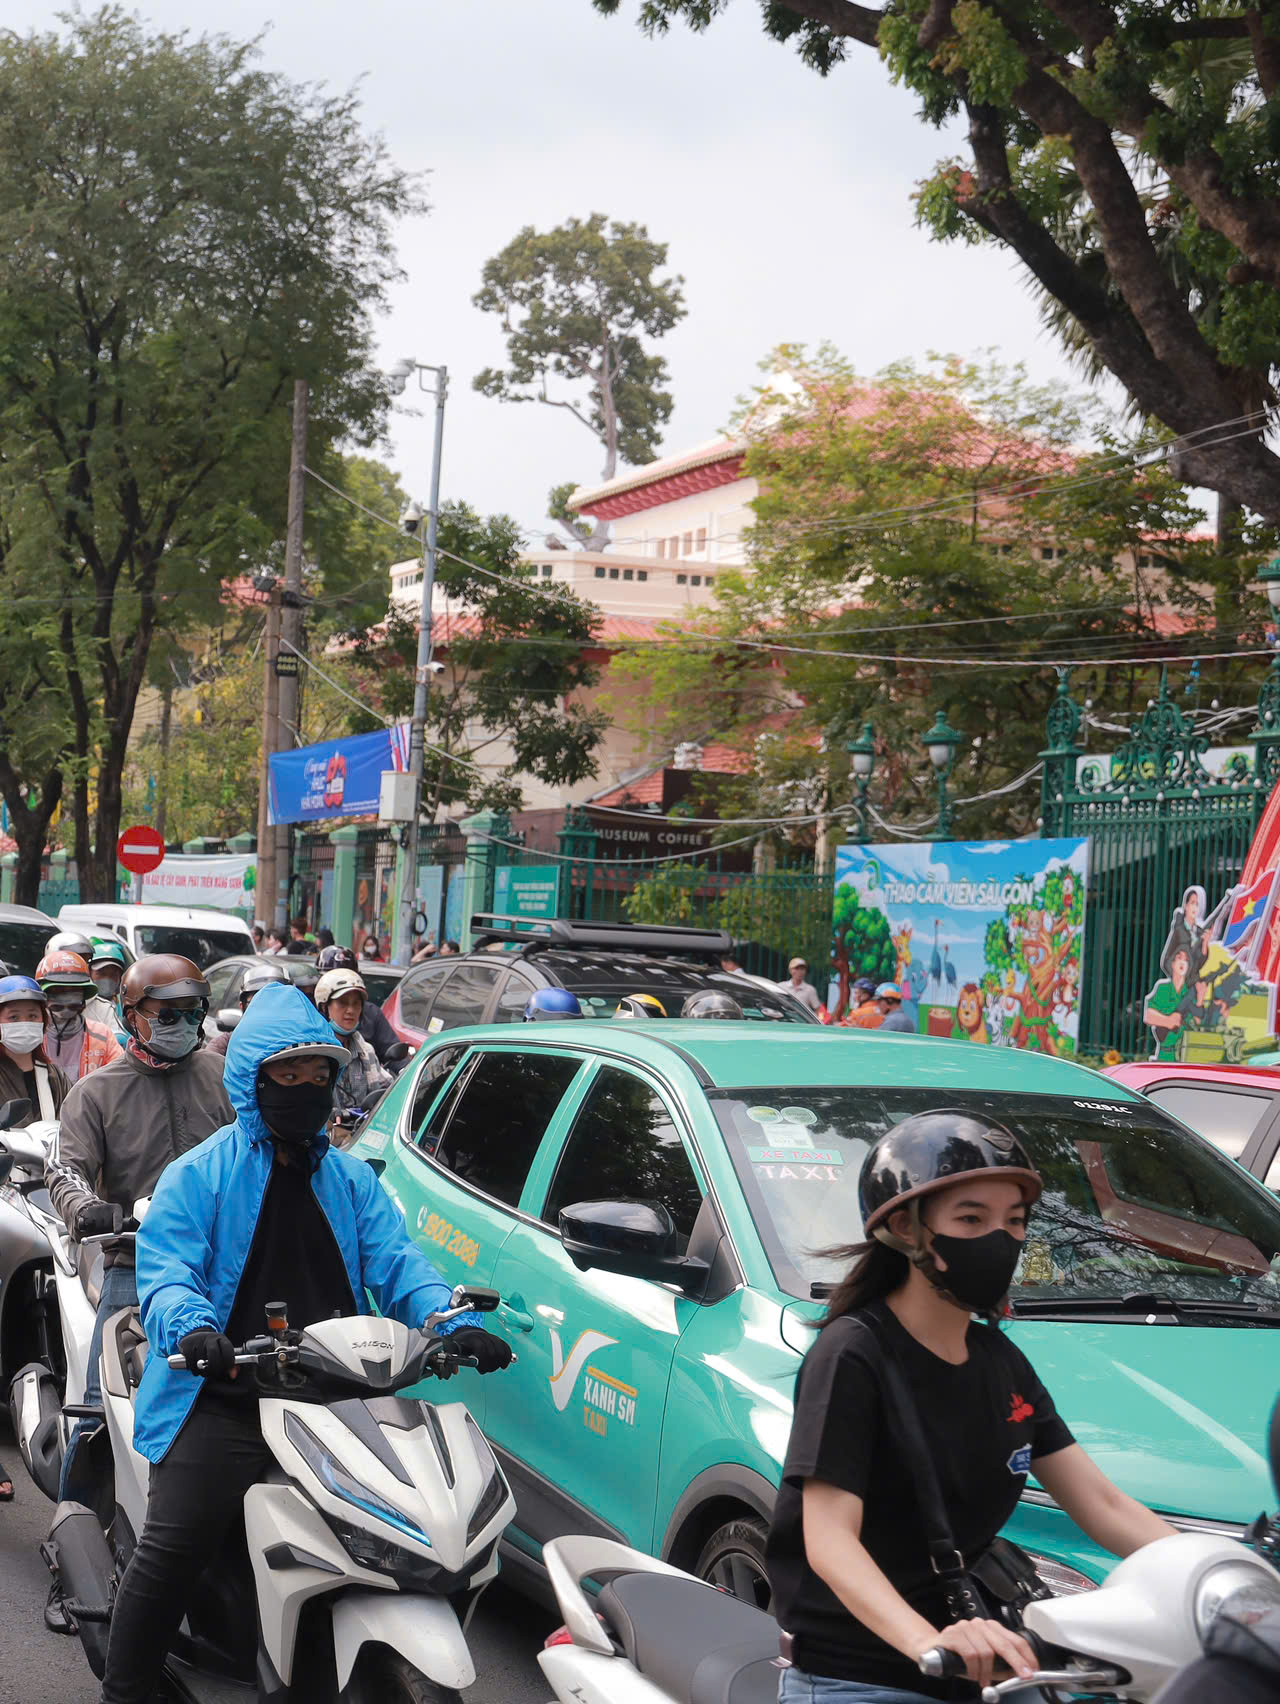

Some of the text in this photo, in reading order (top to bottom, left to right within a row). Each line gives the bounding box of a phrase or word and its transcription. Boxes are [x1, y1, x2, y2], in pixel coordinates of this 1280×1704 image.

[594, 829, 703, 845] MUSEUM COFFEE
[761, 1150, 832, 1160] XE TAXI
[760, 1165, 839, 1181] TAXI
[583, 1375, 636, 1426] XANH SM
